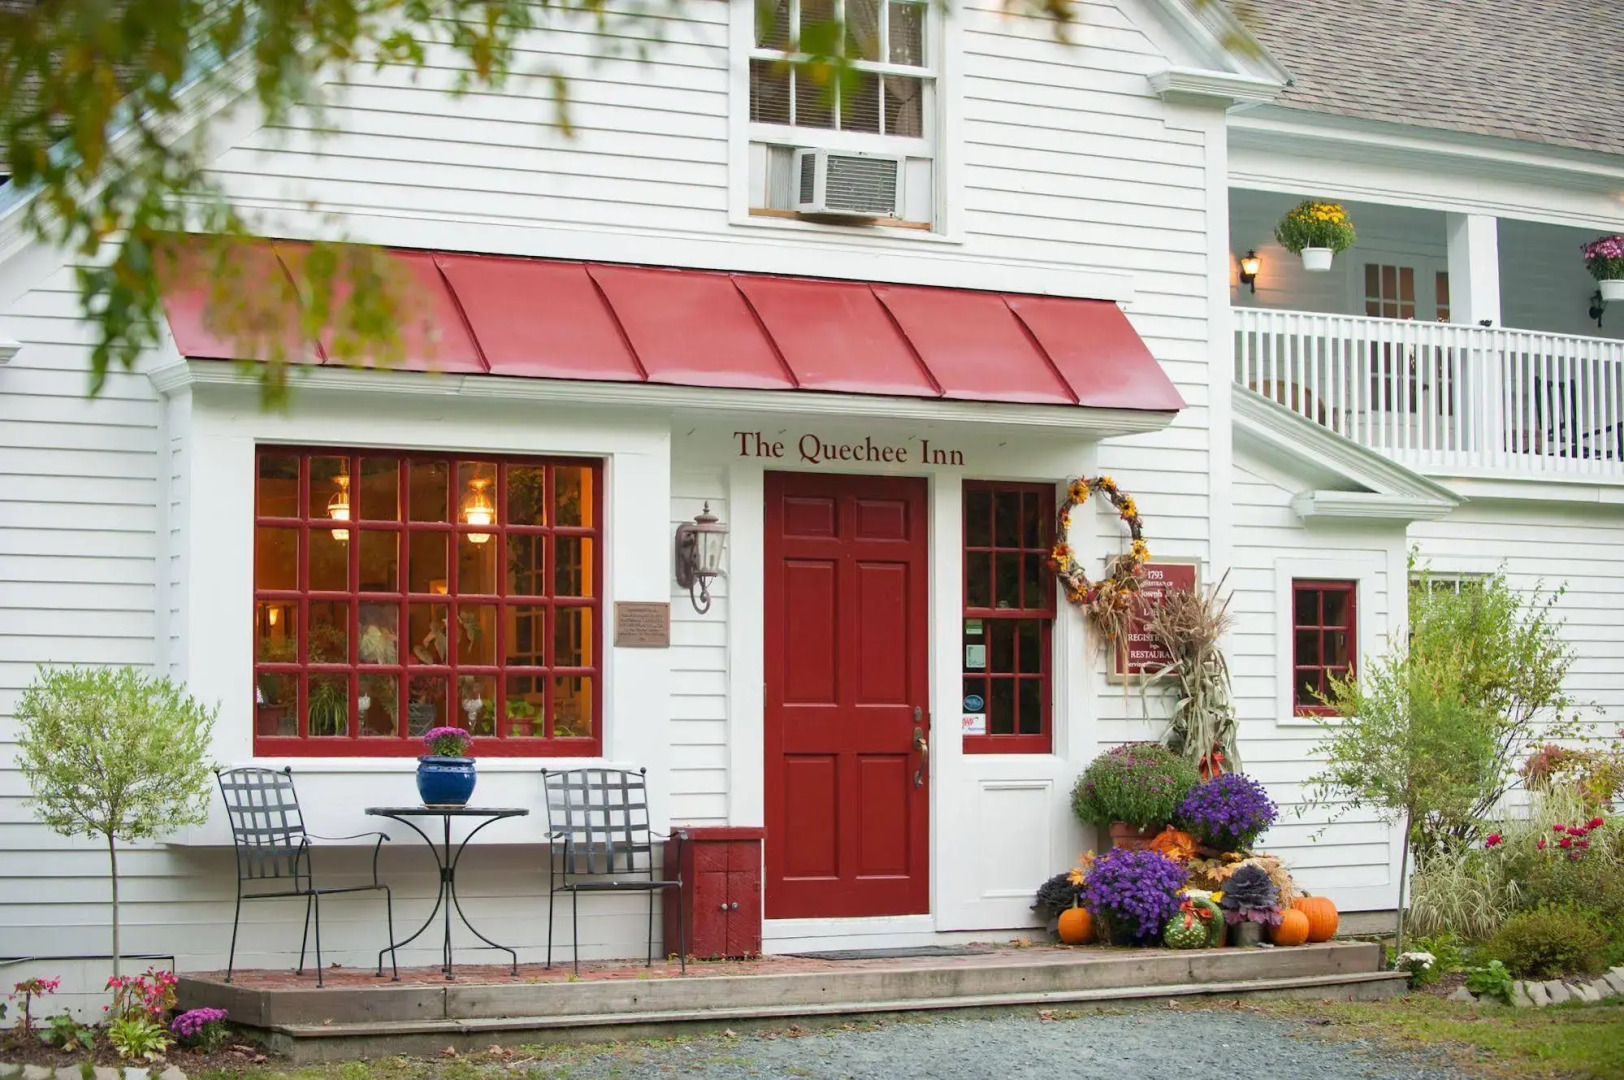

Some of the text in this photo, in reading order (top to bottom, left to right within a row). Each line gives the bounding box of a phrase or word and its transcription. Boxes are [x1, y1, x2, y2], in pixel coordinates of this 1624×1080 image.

[732, 431, 966, 466] The Quechee Inn
[1148, 570, 1163, 580] 1793
